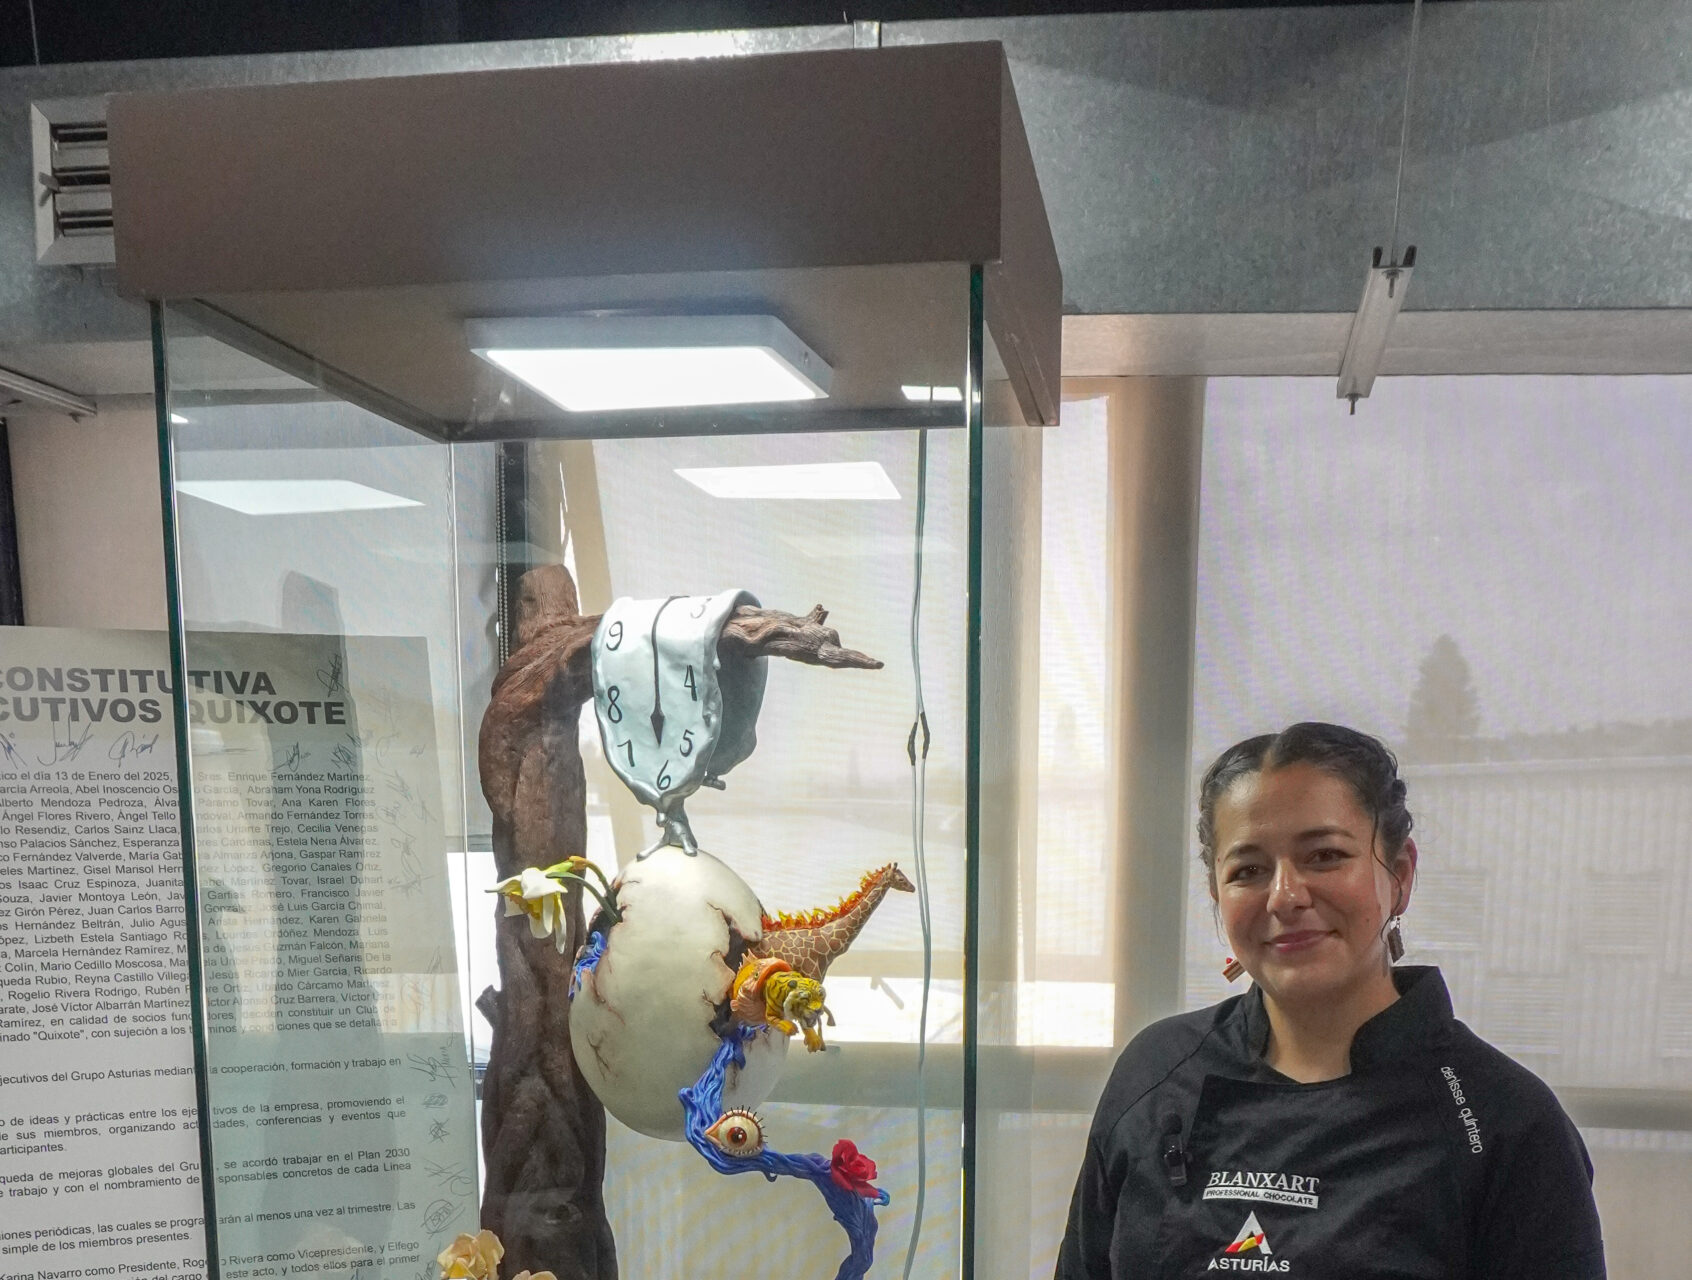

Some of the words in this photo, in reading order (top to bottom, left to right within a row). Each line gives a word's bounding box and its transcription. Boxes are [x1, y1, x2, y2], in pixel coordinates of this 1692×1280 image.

[606, 620, 624, 651] 9
[684, 665, 697, 701] 4
[607, 685, 622, 723] 8
[189, 700, 346, 725] QUIXOTE
[679, 729, 694, 757] 5
[617, 739, 635, 767] 7
[89, 771, 120, 780] Enero
[657, 760, 671, 790] 6
[30, 784, 72, 794] Arreola,
[103, 784, 160, 793] Inoscencio
[41, 798, 91, 807] Mendoza
[99, 798, 146, 808] Pedroza,
[309, 798, 338, 807] Karen
[38, 811, 72, 820] Flores
[76, 811, 113, 821] Rivero,
[118, 809, 148, 822] Ángel
[15, 825, 70, 835] Resendiz,
[74, 825, 110, 834] Carlos
[20, 838, 66, 847] Palacios
[70, 837, 120, 848] Sánchez,
[124, 837, 179, 848] Esperanza
[14, 852, 72, 861] Fernández
[76, 851, 126, 862] Valverde,
[300, 849, 336, 860] Gaspar
[28, 866, 78, 876] Martínez,
[310, 862, 351, 871] Canales
[19, 879, 48, 889] Isaac
[87, 878, 140, 890] Espinoza,
[146, 878, 184, 887] Juanita
[79, 892, 125, 903] Montoya
[131, 891, 160, 901] León,
[301, 888, 350, 897] Francisco
[15, 907, 44, 917] Girón
[49, 907, 84, 916] Pérez,
[118, 905, 152, 914] Carlos
[16, 920, 75, 930] Hernández
[82, 919, 124, 929] Beltrán,
[310, 914, 339, 923] Karen
[35, 934, 74, 944] Lizbeth
[80, 933, 114, 942] Estela
[120, 932, 168, 943] Santiago
[15, 948, 58, 958] Marcela
[62, 946, 121, 957] Hernández
[75, 960, 112, 970] Cedillo
[116, 960, 166, 969] Moscosa,
[288, 954, 322, 965] Miguel
[75, 975, 110, 986] Reyna
[114, 973, 154, 983] Castillo
[8, 990, 50, 1002] Rogelio
[56, 989, 90, 998] Rivera
[95, 987, 140, 998] Rodrigo,
[146, 985, 180, 995] Rubén
[96, 1000, 140, 1010] Albarrán
[70, 1015, 108, 1026] calidad
[132, 1013, 166, 1023] socios
[288, 1006, 333, 1016] constituir
[33, 1030, 88, 1041] "Quixote",
[114, 1027, 158, 1039] sujeción
[71, 1072, 105, 1082] Grupo
[108, 1069, 151, 1079] Asturias
[221, 1062, 288, 1075] cooperación,
[291, 1059, 340, 1070] formación
[352, 1057, 386, 1068] trabajo
[1441, 1066, 1466, 1105] denisse
[30, 1115, 60, 1125] ideas
[76, 1111, 124, 1124] prácticas
[274, 1101, 322, 1112] empresa,
[327, 1095, 392, 1109] promoviendo
[44, 1127, 100, 1138] miembros,
[109, 1122, 176, 1136] organizando
[256, 1114, 322, 1126] conferencias
[342, 1111, 380, 1121] eventos
[1458, 1108, 1483, 1153] quintero
[59, 1169, 102, 1181] mejoras
[108, 1165, 153, 1178] globales
[283, 1154, 322, 1166] trabajar
[10, 1186, 48, 1197] trabajo
[104, 1177, 181, 1190] nombramiento
[282, 1168, 332, 1178] concretos
[1207, 1171, 1319, 1193] BLANXART
[1206, 1189, 1260, 1198] PROFESSIONAL
[1263, 1191, 1313, 1205] CHOCOLATE
[35, 1226, 94, 1240] periódicas,
[116, 1221, 151, 1231] cuales
[256, 1213, 292, 1222] menos
[2, 1243, 38, 1255] simple
[78, 1236, 133, 1248] miembros
[136, 1232, 192, 1245] presentes.
[38, 1271, 82, 1280] Navarro
[85, 1268, 116, 1276] como
[118, 1261, 180, 1273] Presidente,
[230, 1256, 264, 1265] Rivera
[266, 1254, 295, 1262] como
[291, 1263, 320, 1273] todos
